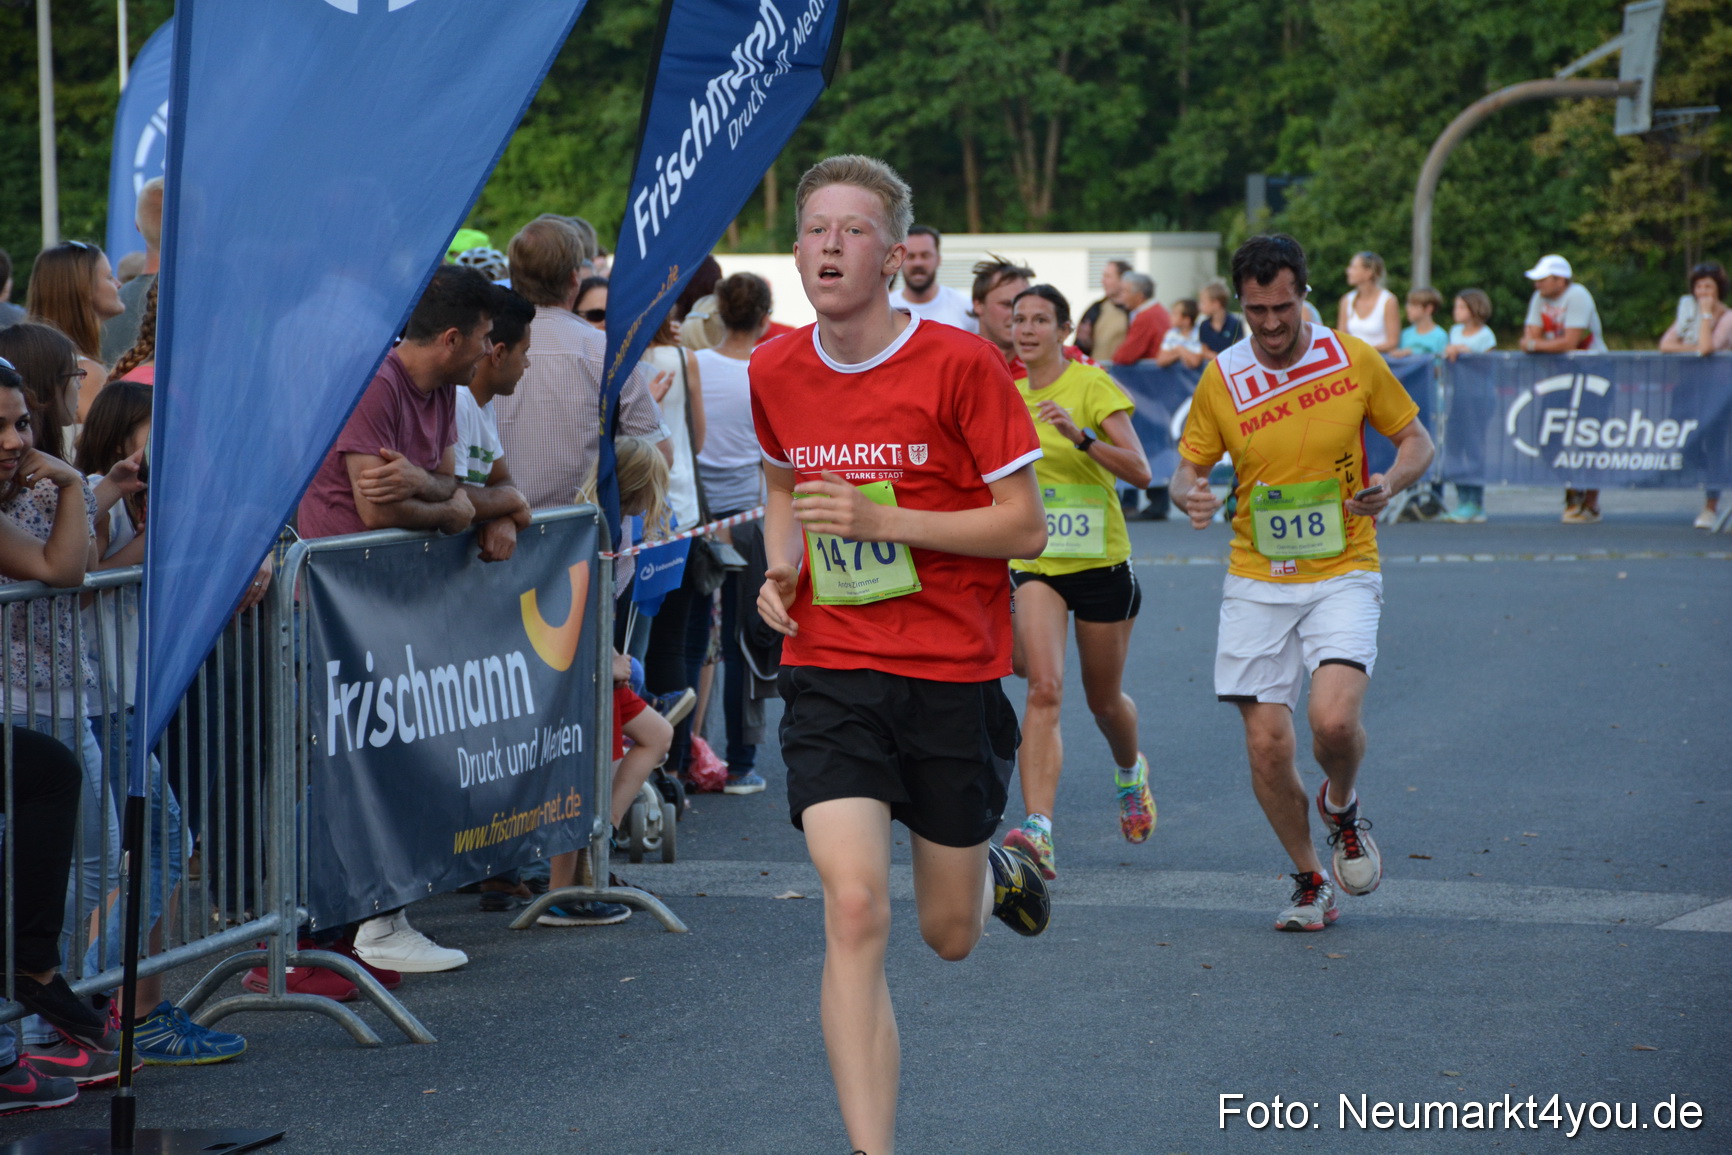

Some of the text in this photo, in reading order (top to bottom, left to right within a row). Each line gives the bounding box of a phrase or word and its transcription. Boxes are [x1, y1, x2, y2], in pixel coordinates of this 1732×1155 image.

[633, 0, 786, 260] Frischmann
[728, 77, 767, 151] Druck
[1239, 376, 1359, 437] MAX BÖGL
[1539, 407, 1698, 449] Fischer
[845, 471, 904, 480] STARKE STADT
[1553, 451, 1683, 470] AUTOMOBILE
[1046, 513, 1090, 537] 603
[1270, 511, 1325, 540] 918
[816, 536, 897, 573] 1470
[852, 577, 880, 589] Zimmer
[326, 644, 535, 757] Frischmann
[457, 736, 504, 788] Druck
[506, 727, 538, 777] und
